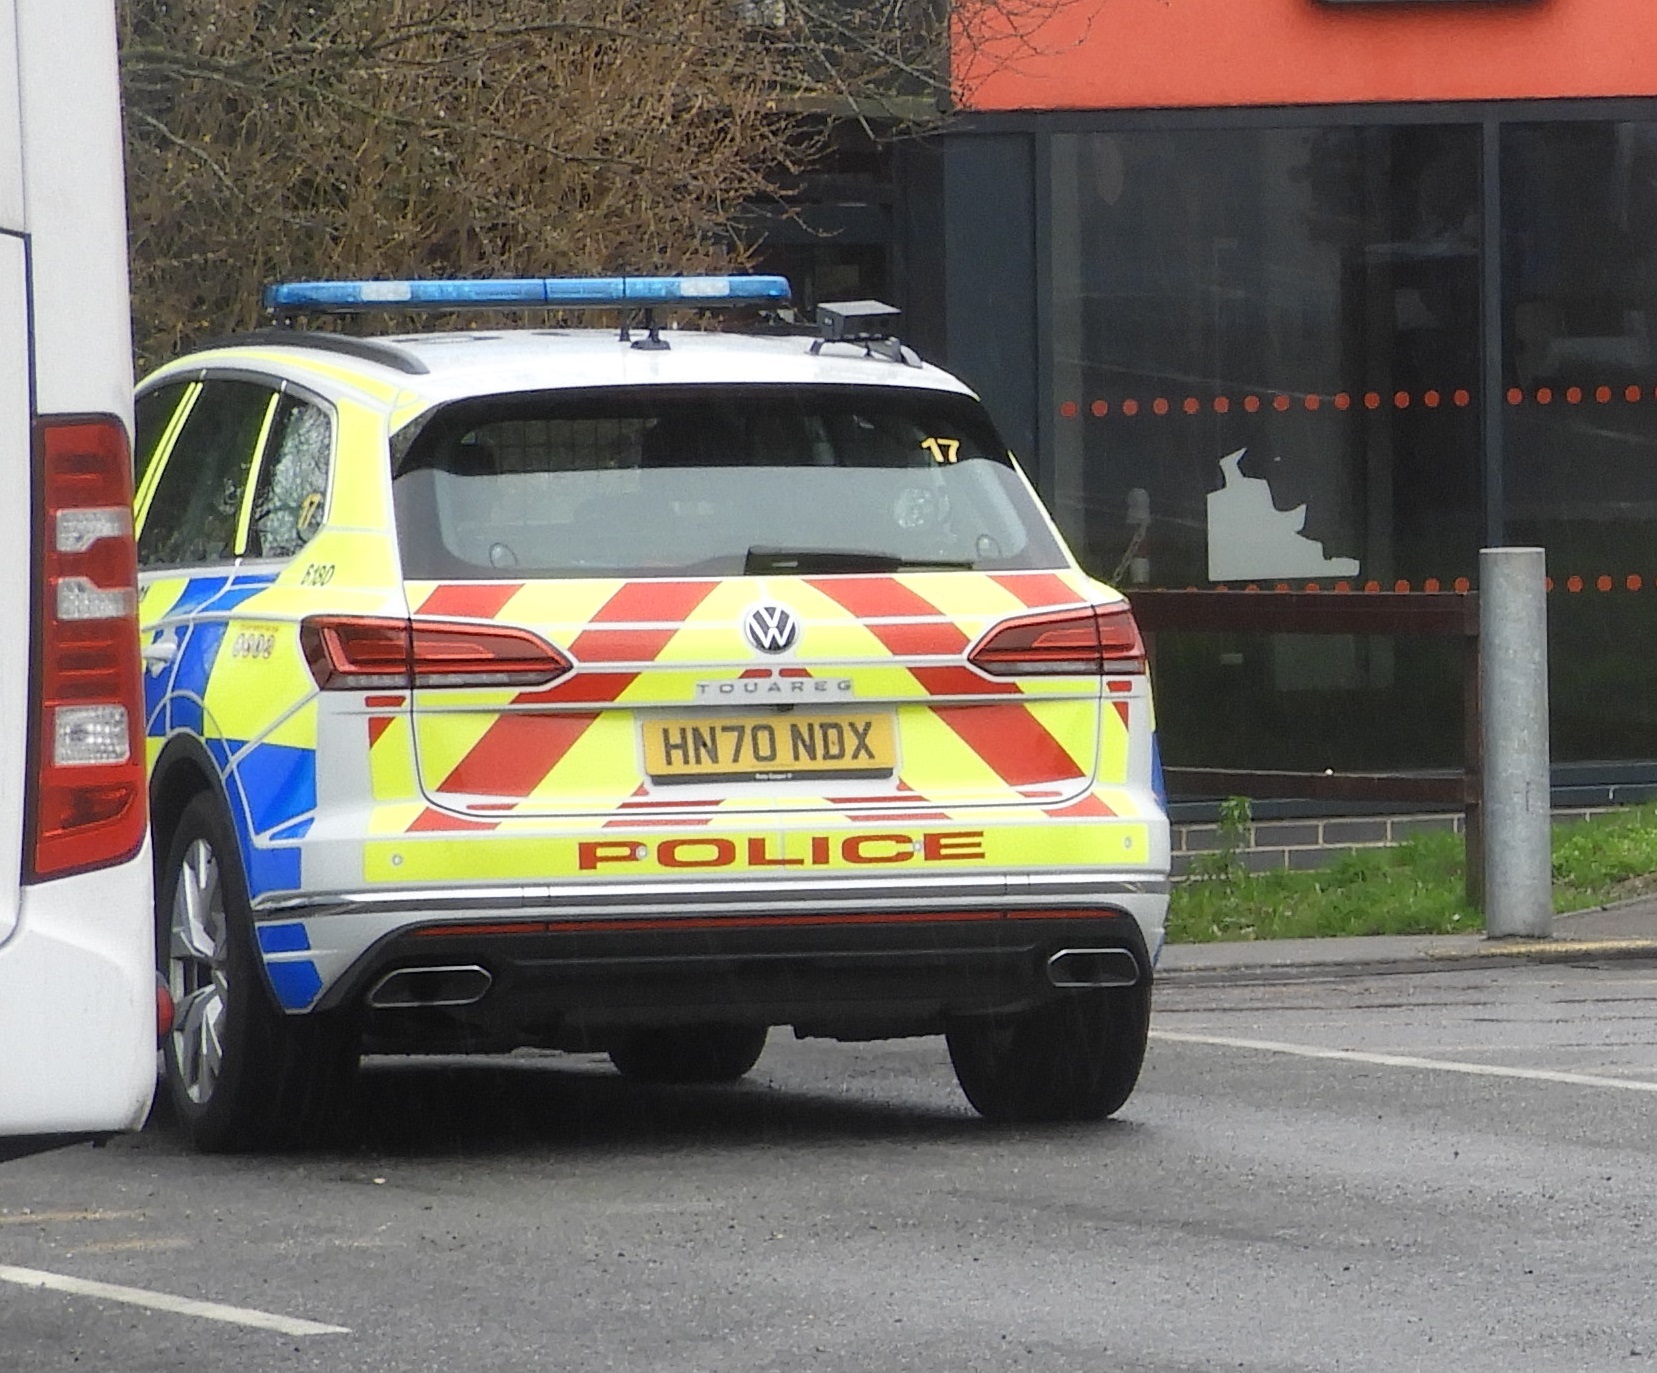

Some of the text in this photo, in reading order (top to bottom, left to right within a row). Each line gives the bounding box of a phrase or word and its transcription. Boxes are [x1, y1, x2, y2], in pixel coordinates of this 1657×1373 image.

[921, 437, 960, 463] 17
[696, 680, 853, 695] TOUAREG
[662, 721, 875, 766] HN70 NDX
[578, 831, 985, 870] POLICE
